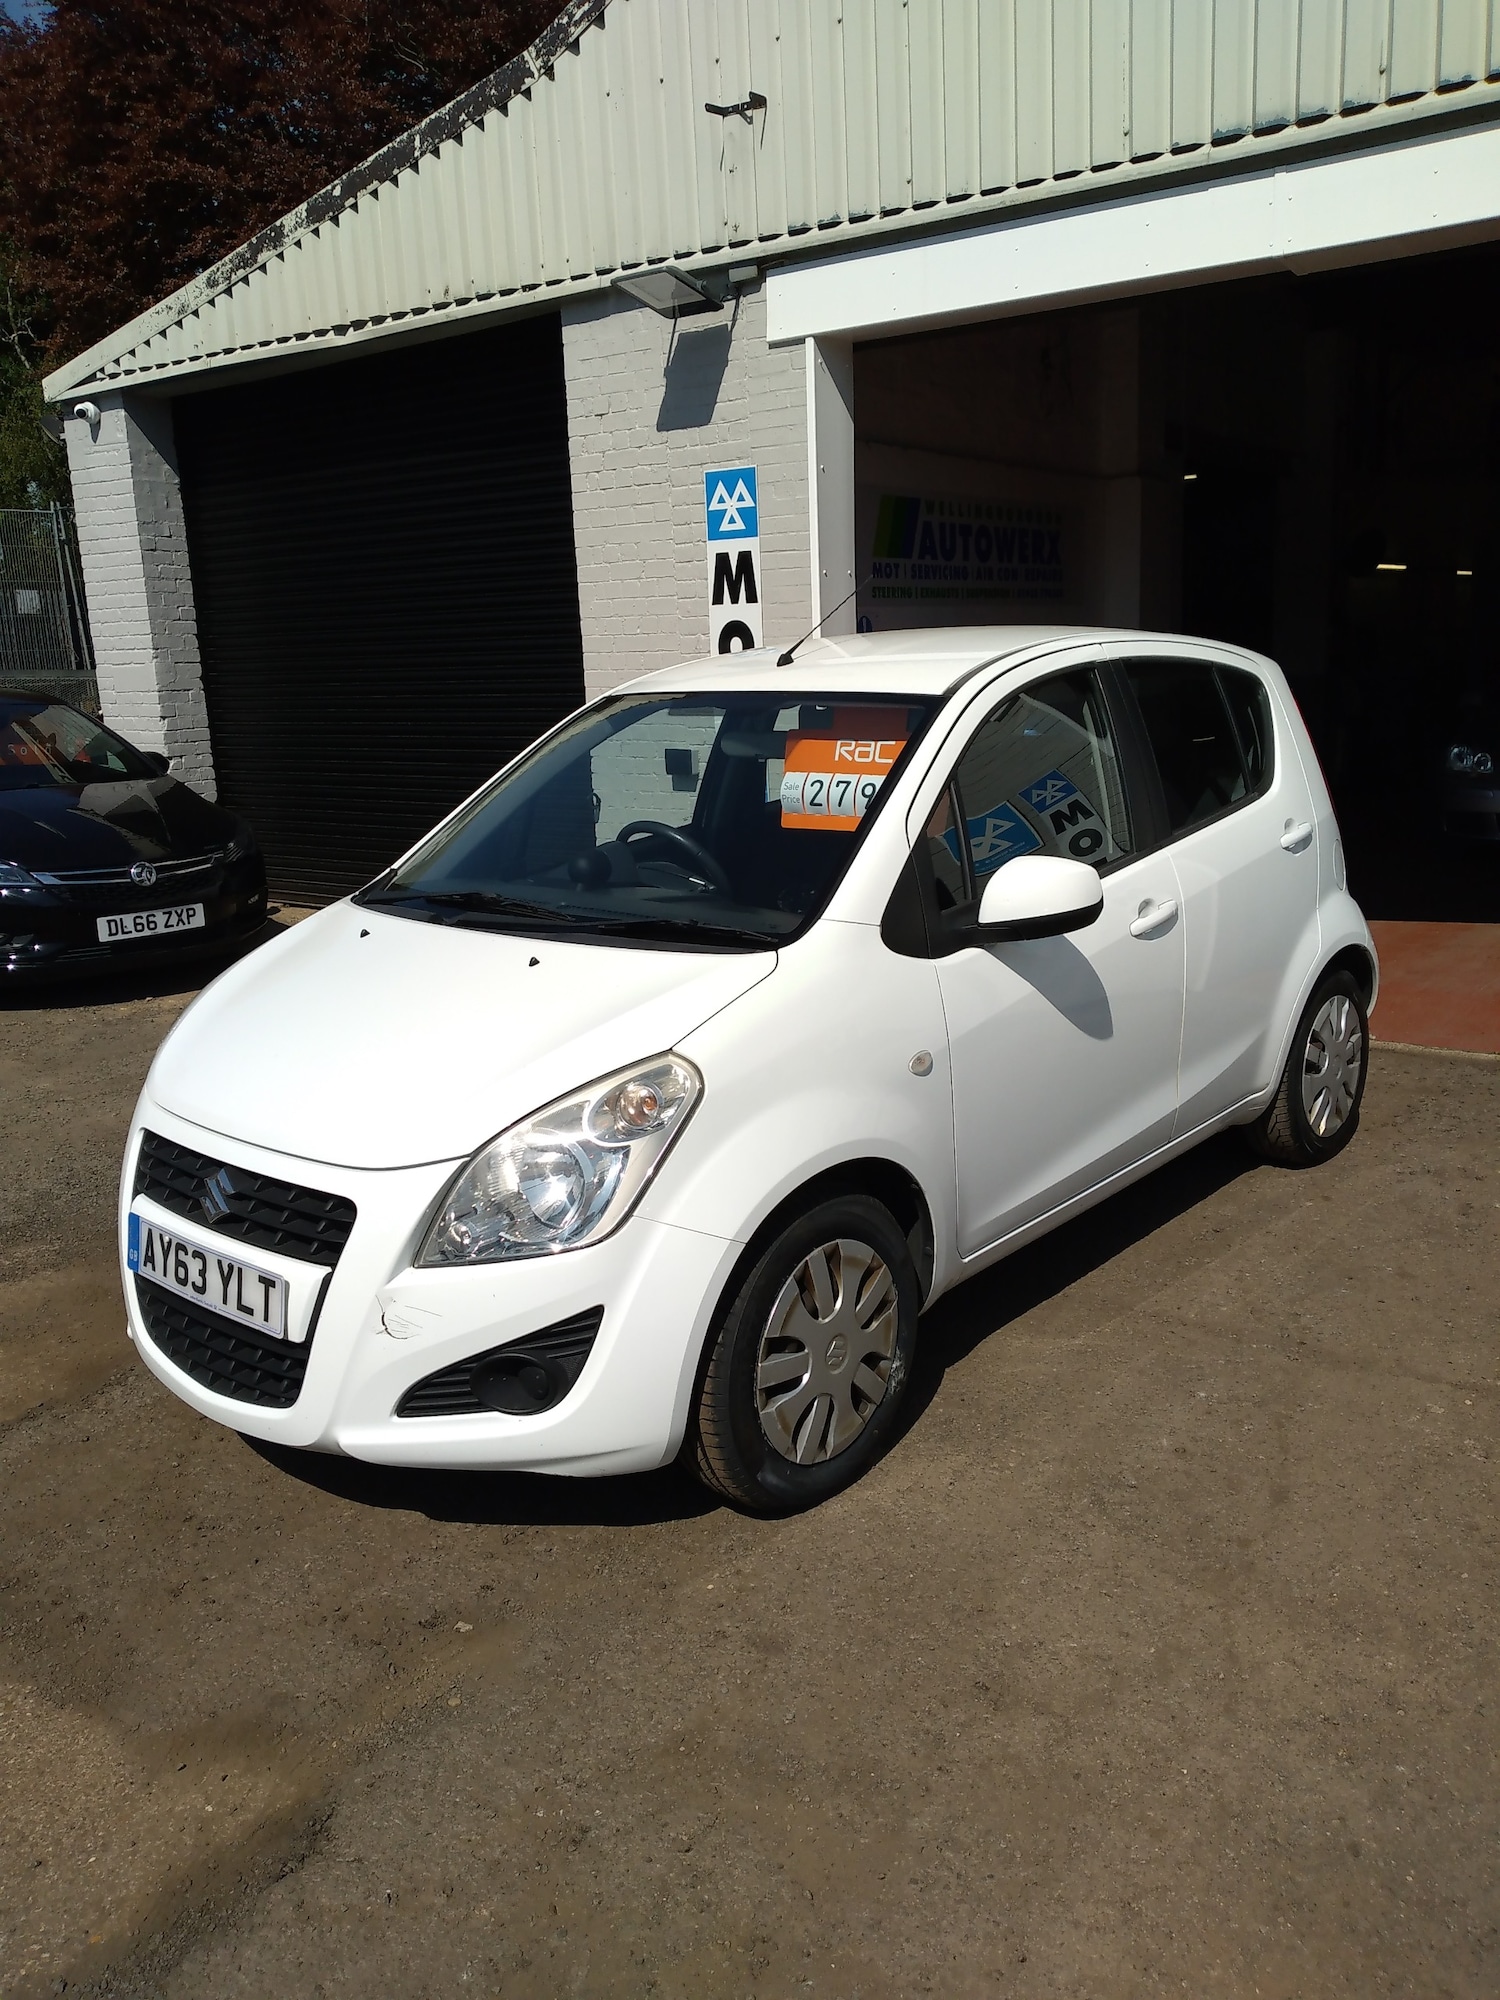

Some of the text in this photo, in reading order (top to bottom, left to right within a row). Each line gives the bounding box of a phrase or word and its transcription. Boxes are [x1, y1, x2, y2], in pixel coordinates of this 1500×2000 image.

[917, 520, 1061, 565] AUTOWERX
[872, 562, 900, 579] MOT
[910, 563, 969, 580] SERVICING
[975, 566, 993, 580] AIR
[997, 567, 1018, 581] CON
[871, 586, 913, 598] STEERING
[783, 781, 800, 791] Sale
[781, 794, 801, 805] Price
[106, 907, 197, 937] DL66 ZXP
[129, 1248, 138, 1261] GB
[143, 1227, 276, 1323] AY63 YLT
